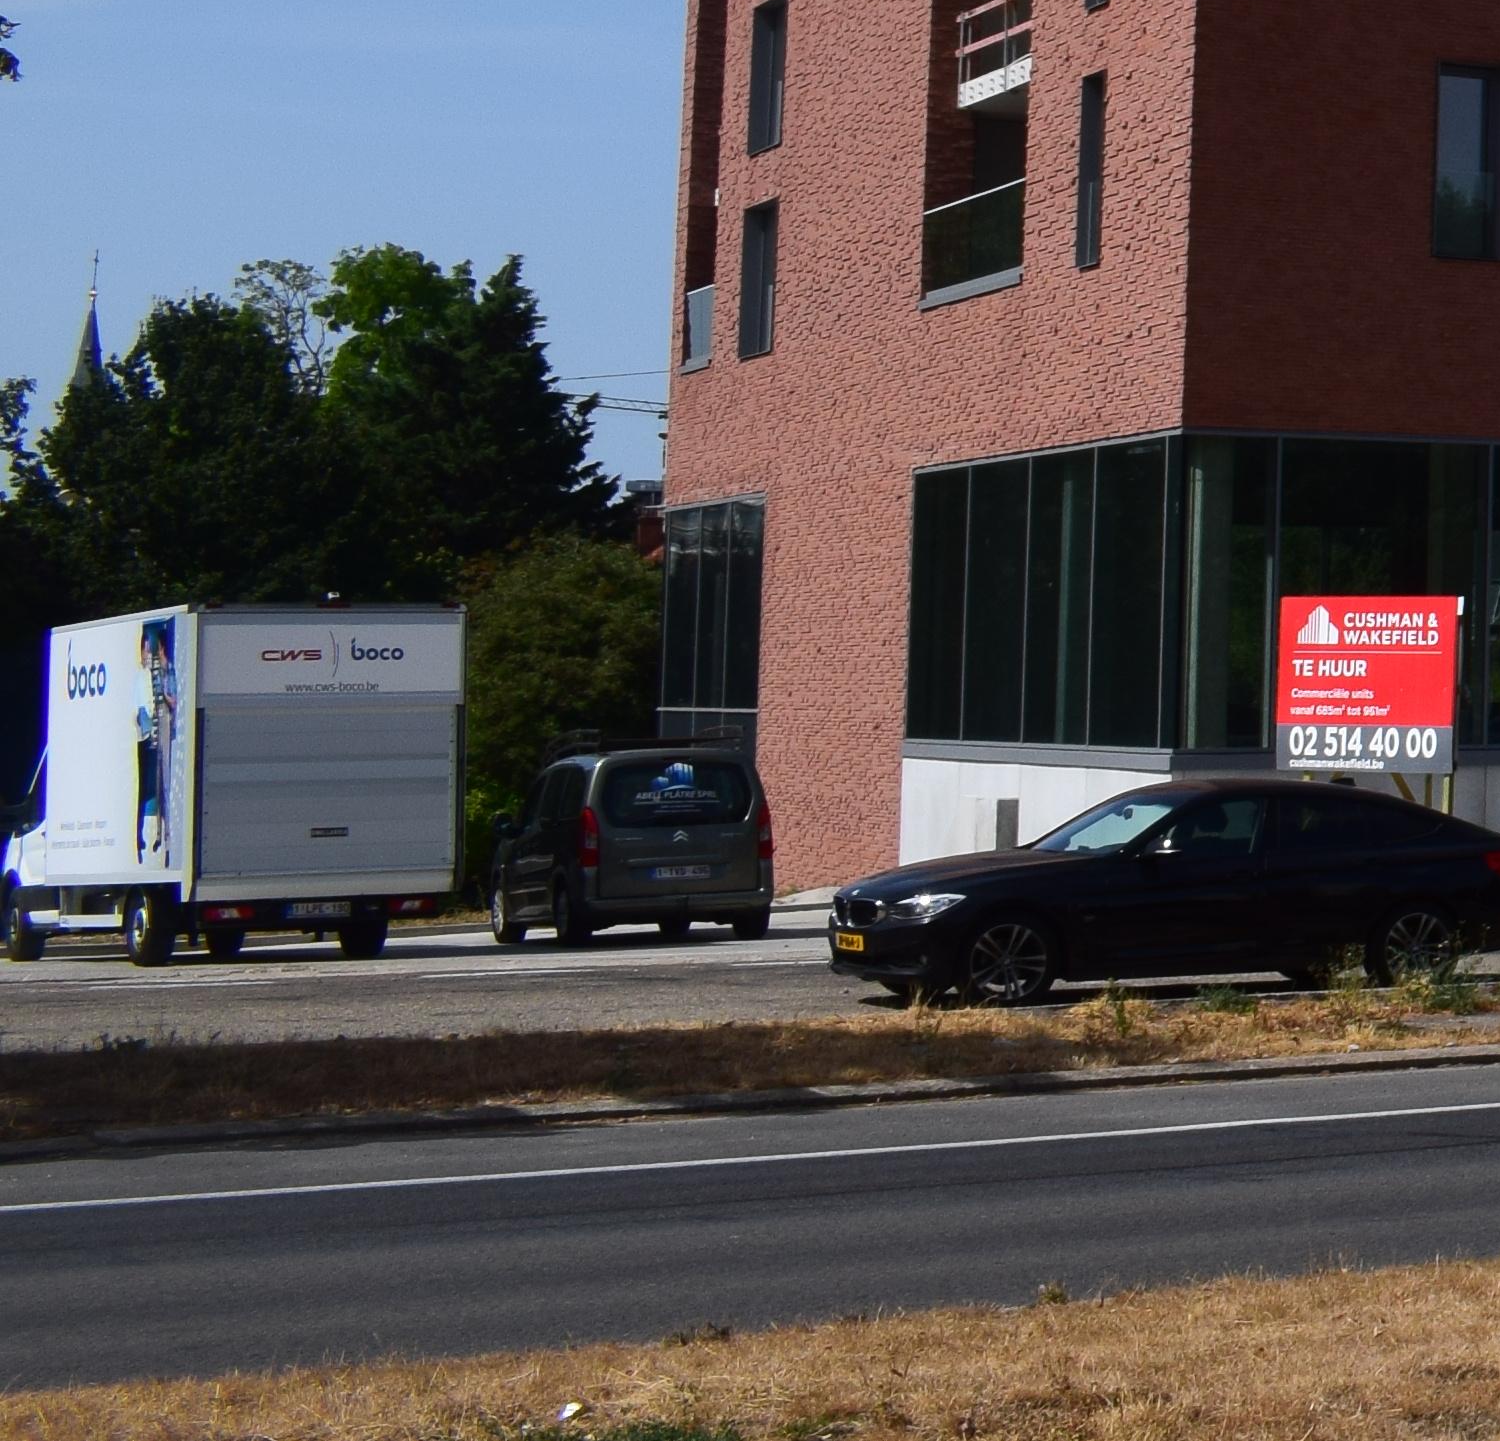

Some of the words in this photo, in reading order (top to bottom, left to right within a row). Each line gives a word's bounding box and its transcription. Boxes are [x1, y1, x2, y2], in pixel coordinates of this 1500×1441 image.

[1344, 613, 1423, 628] CUSHMAN
[1427, 613, 1439, 628] &
[1344, 630, 1439, 645] WAKEFIELD
[261, 649, 322, 661] CWS
[351, 637, 404, 661] boco
[67, 639, 106, 700] boco
[1292, 660, 1314, 677] TE
[1318, 660, 1367, 677] HUUR
[285, 681, 379, 692] www.cws-boco.be
[1351, 689, 1374, 699] units
[1290, 705, 1315, 715] vanaf
[1347, 706, 1361, 716] tot
[1289, 726, 1317, 756] 02
[1324, 726, 1362, 757] 514
[1369, 727, 1400, 758] 40
[1406, 728, 1437, 759] 00
[1289, 759, 1385, 769] cushmanwakefield.be
